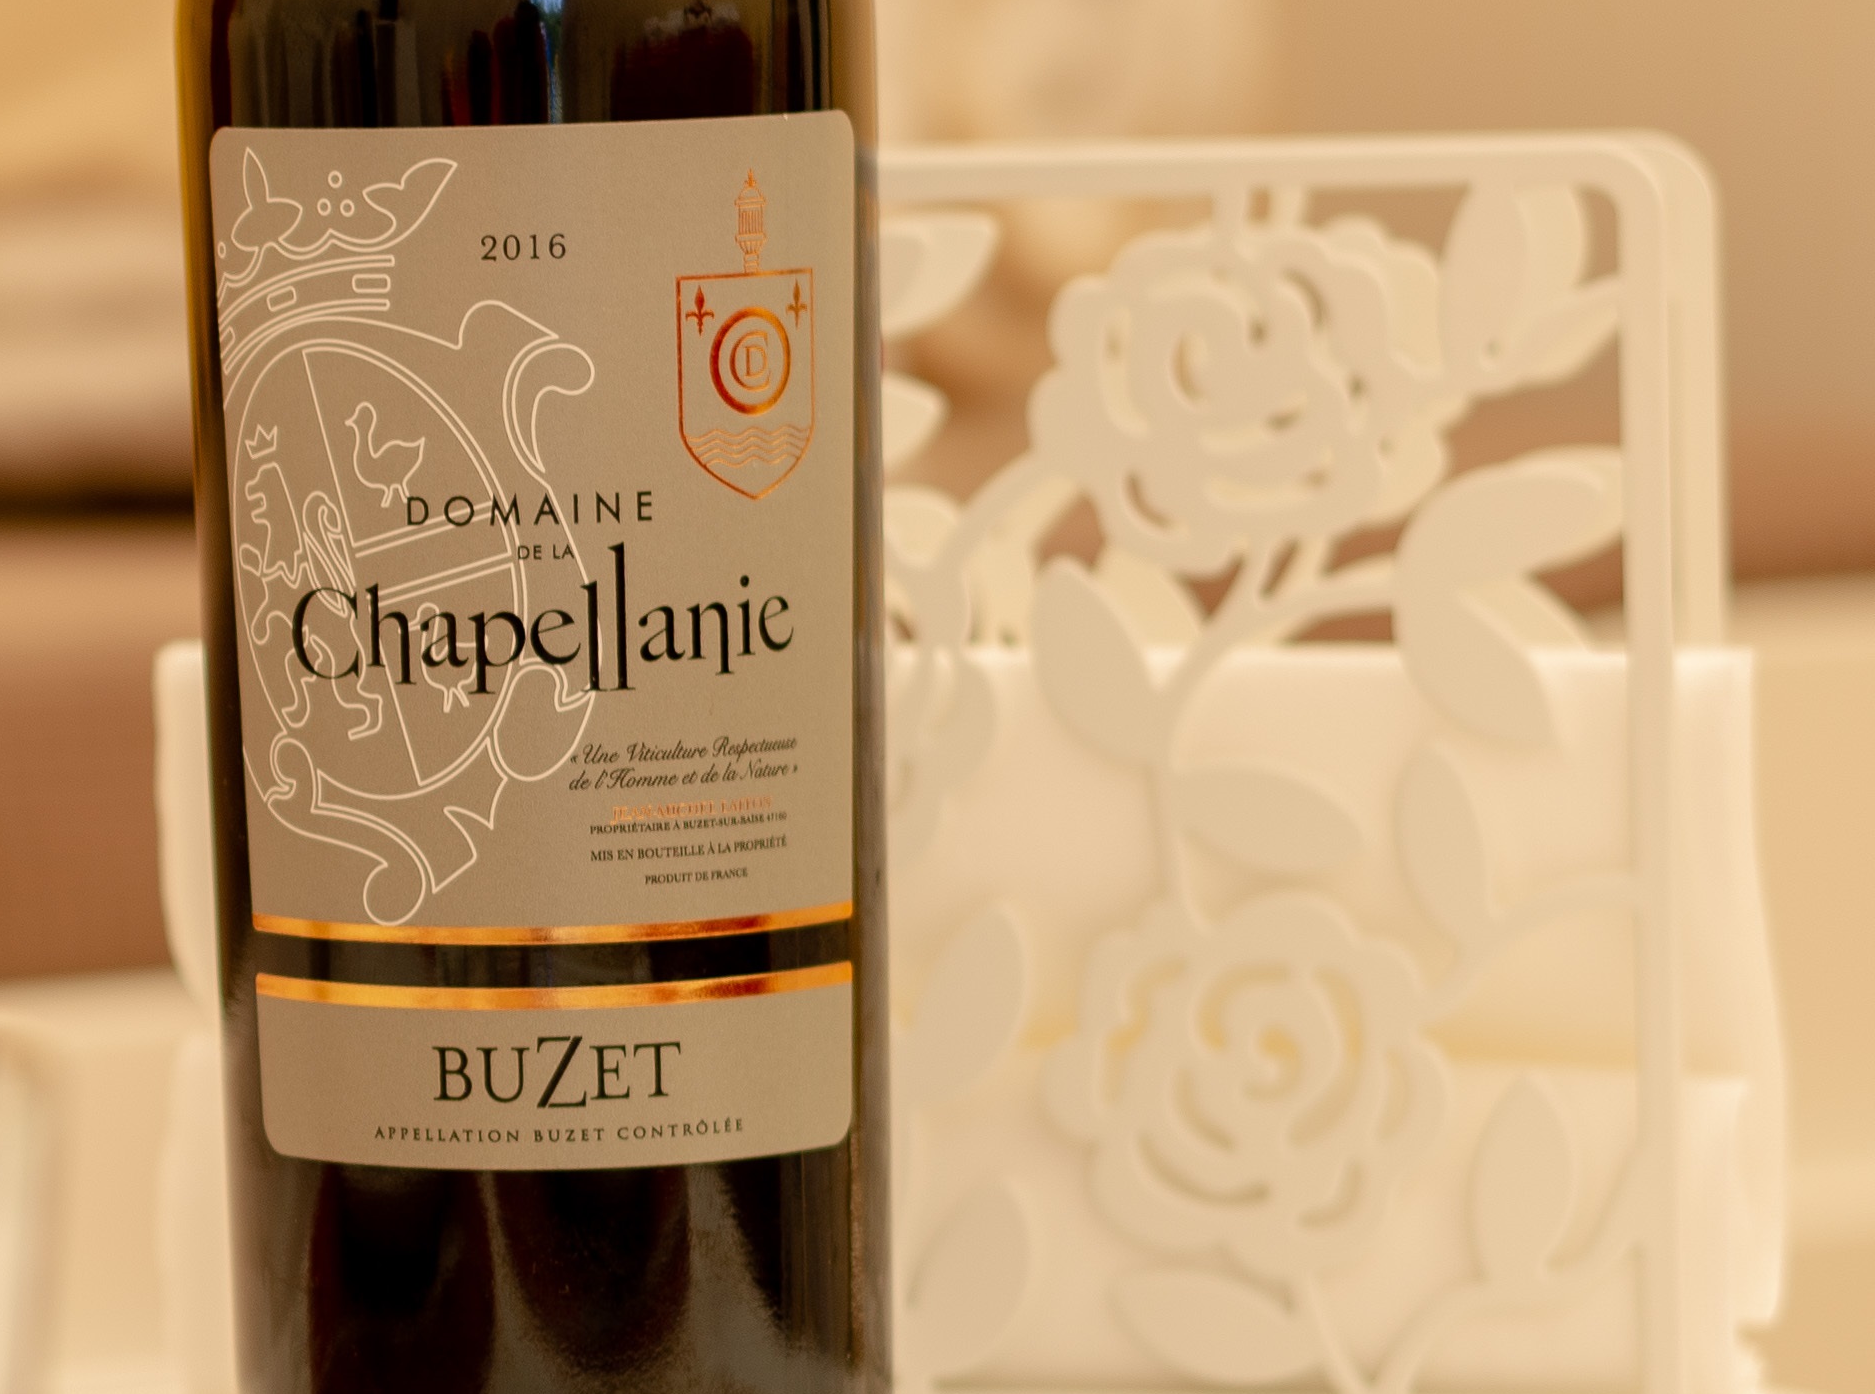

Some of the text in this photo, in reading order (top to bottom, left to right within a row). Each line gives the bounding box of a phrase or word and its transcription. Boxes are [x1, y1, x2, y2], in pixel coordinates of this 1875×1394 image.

[480, 233, 567, 262] 2016
[406, 491, 654, 527] DOMAINE
[517, 542, 576, 561] DE LA
[292, 542, 794, 695] Chapellanie
[583, 743, 620, 765] Une
[626, 740, 708, 764] Viticulture
[713, 736, 798, 763] Respectueuse
[569, 770, 590, 791] de
[682, 771, 697, 785] et
[700, 763, 720, 784] de
[722, 762, 738, 782] la
[590, 821, 671, 835] PROPRIÉTAIRE
[673, 819, 681, 831] À
[590, 834, 787, 862] MIS EN BOUTEILLE À LA PROPRIÉTÉ
[645, 867, 748, 885] PRODUIT DE FRANCE
[432, 1035, 682, 1109] BUZET
[375, 1117, 744, 1143] APPELLATION BUZET CONTRÔLÉE
